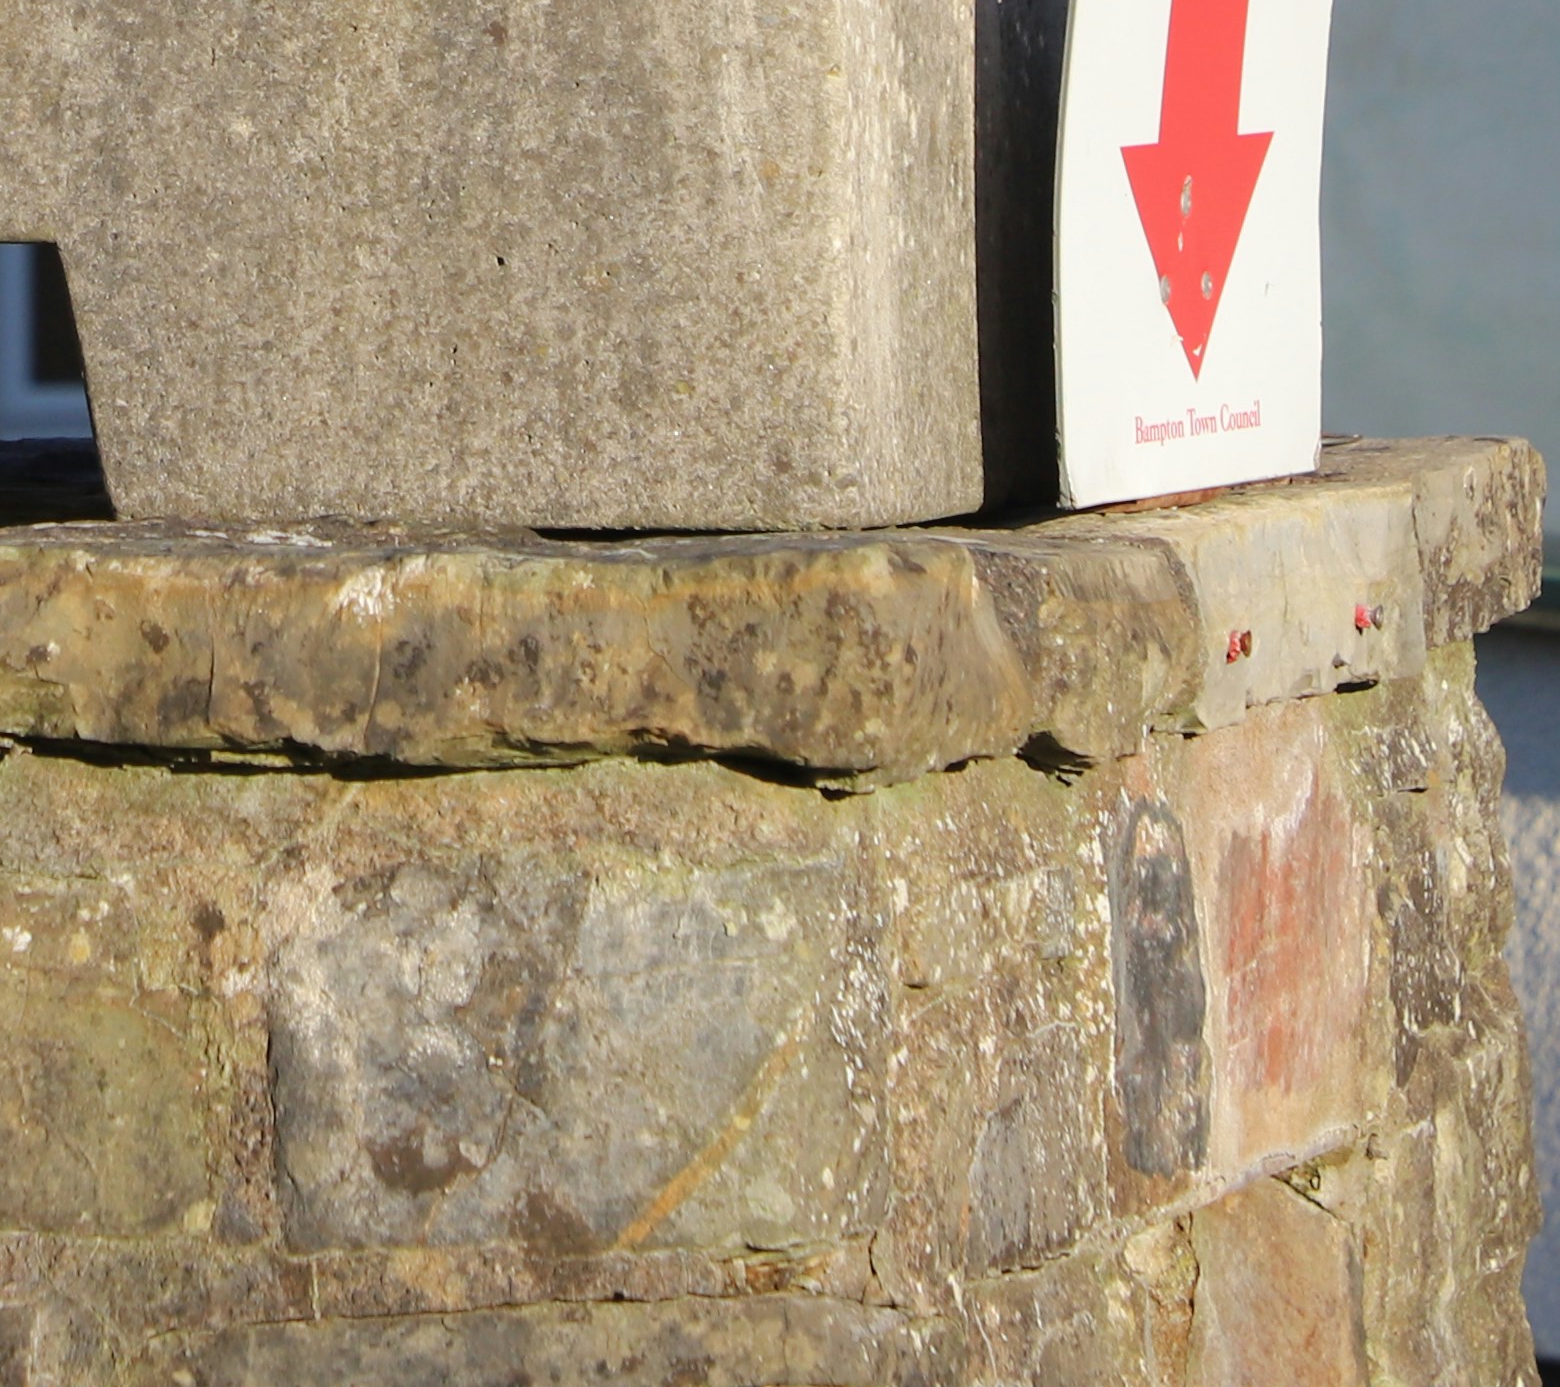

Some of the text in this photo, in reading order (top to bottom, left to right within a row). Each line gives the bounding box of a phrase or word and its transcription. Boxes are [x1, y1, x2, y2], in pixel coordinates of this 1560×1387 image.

[1134, 400, 1261, 446] Bampton Town Council
